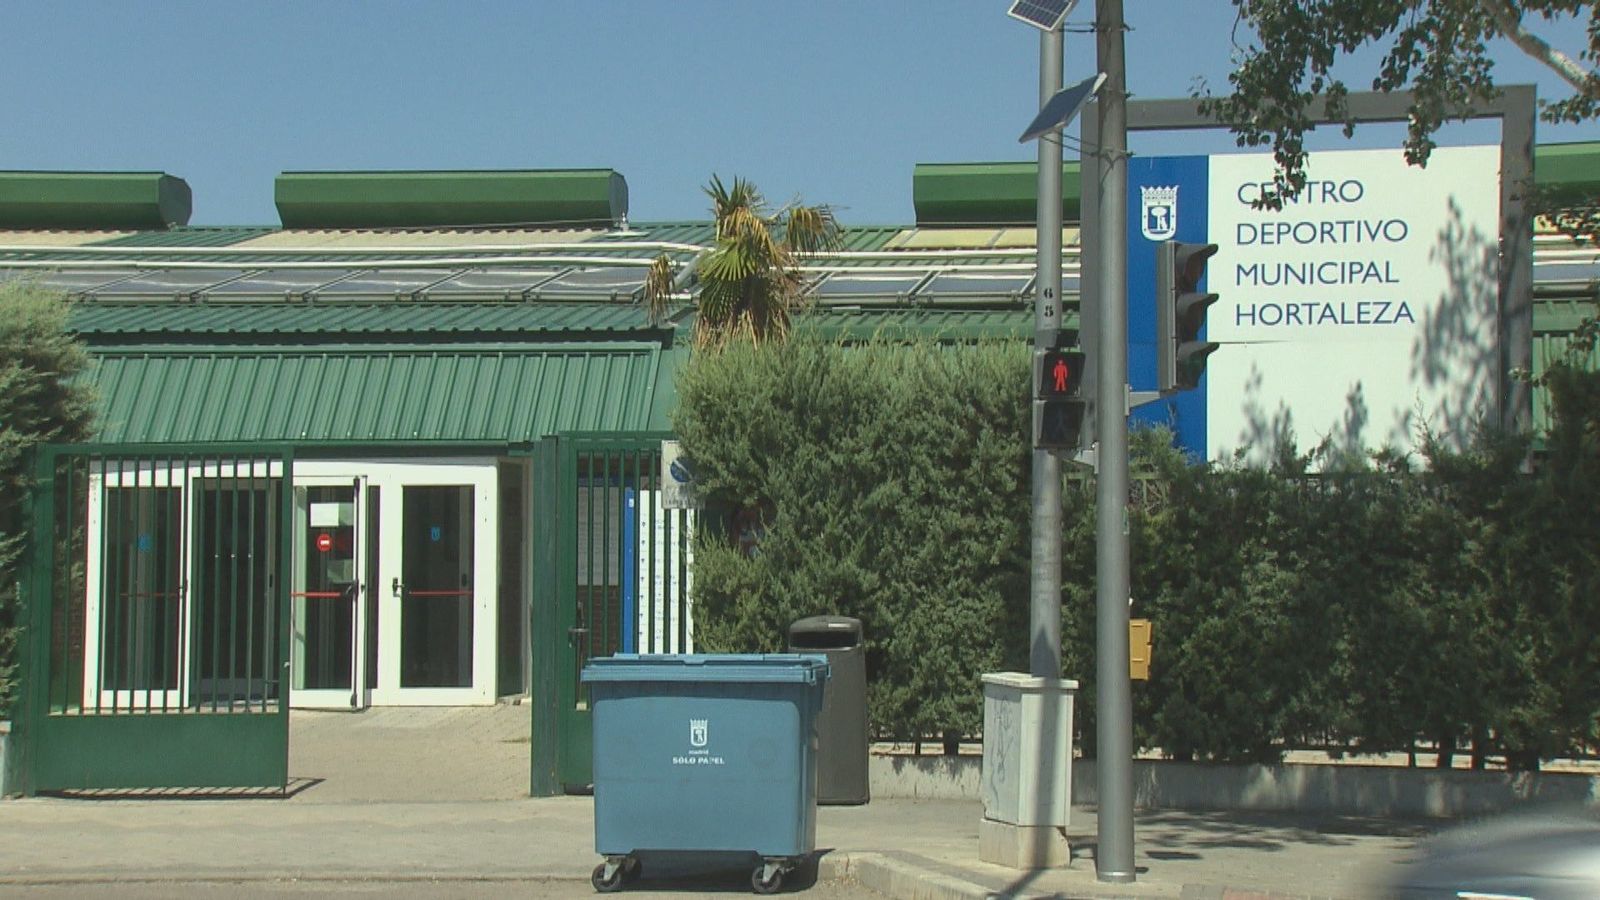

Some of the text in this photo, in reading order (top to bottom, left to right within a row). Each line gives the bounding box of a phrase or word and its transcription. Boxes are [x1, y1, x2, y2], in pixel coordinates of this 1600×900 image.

[1236, 219, 1408, 246] DEPORTIVO
[1236, 260, 1400, 286] MUNICIPAL
[1236, 301, 1416, 326] HORTALEZA
